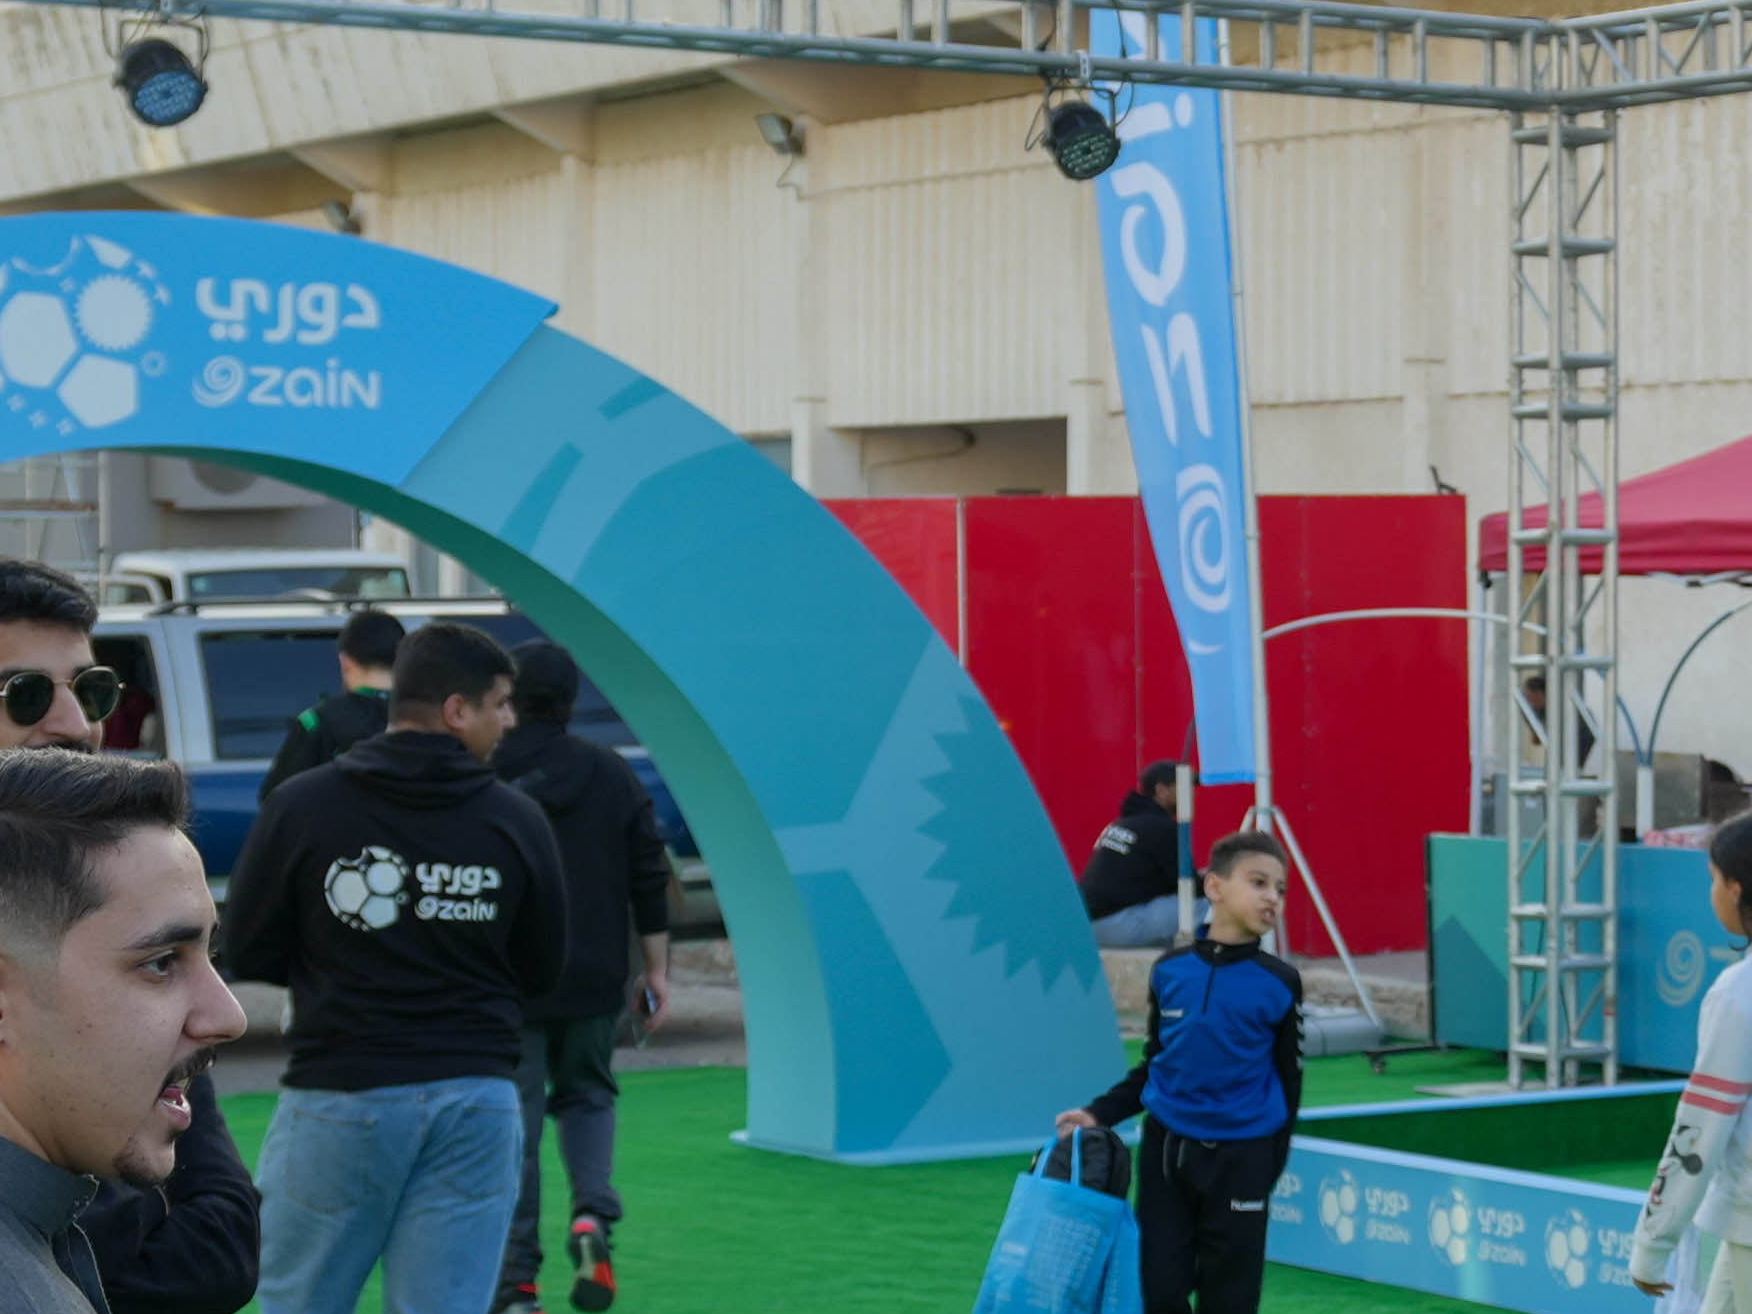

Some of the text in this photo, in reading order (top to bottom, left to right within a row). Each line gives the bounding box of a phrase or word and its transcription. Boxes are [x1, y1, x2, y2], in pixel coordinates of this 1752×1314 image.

[196, 277, 379, 345] دوري
[415, 862, 501, 896] دوري
[1599, 1228, 1636, 1259] وري
